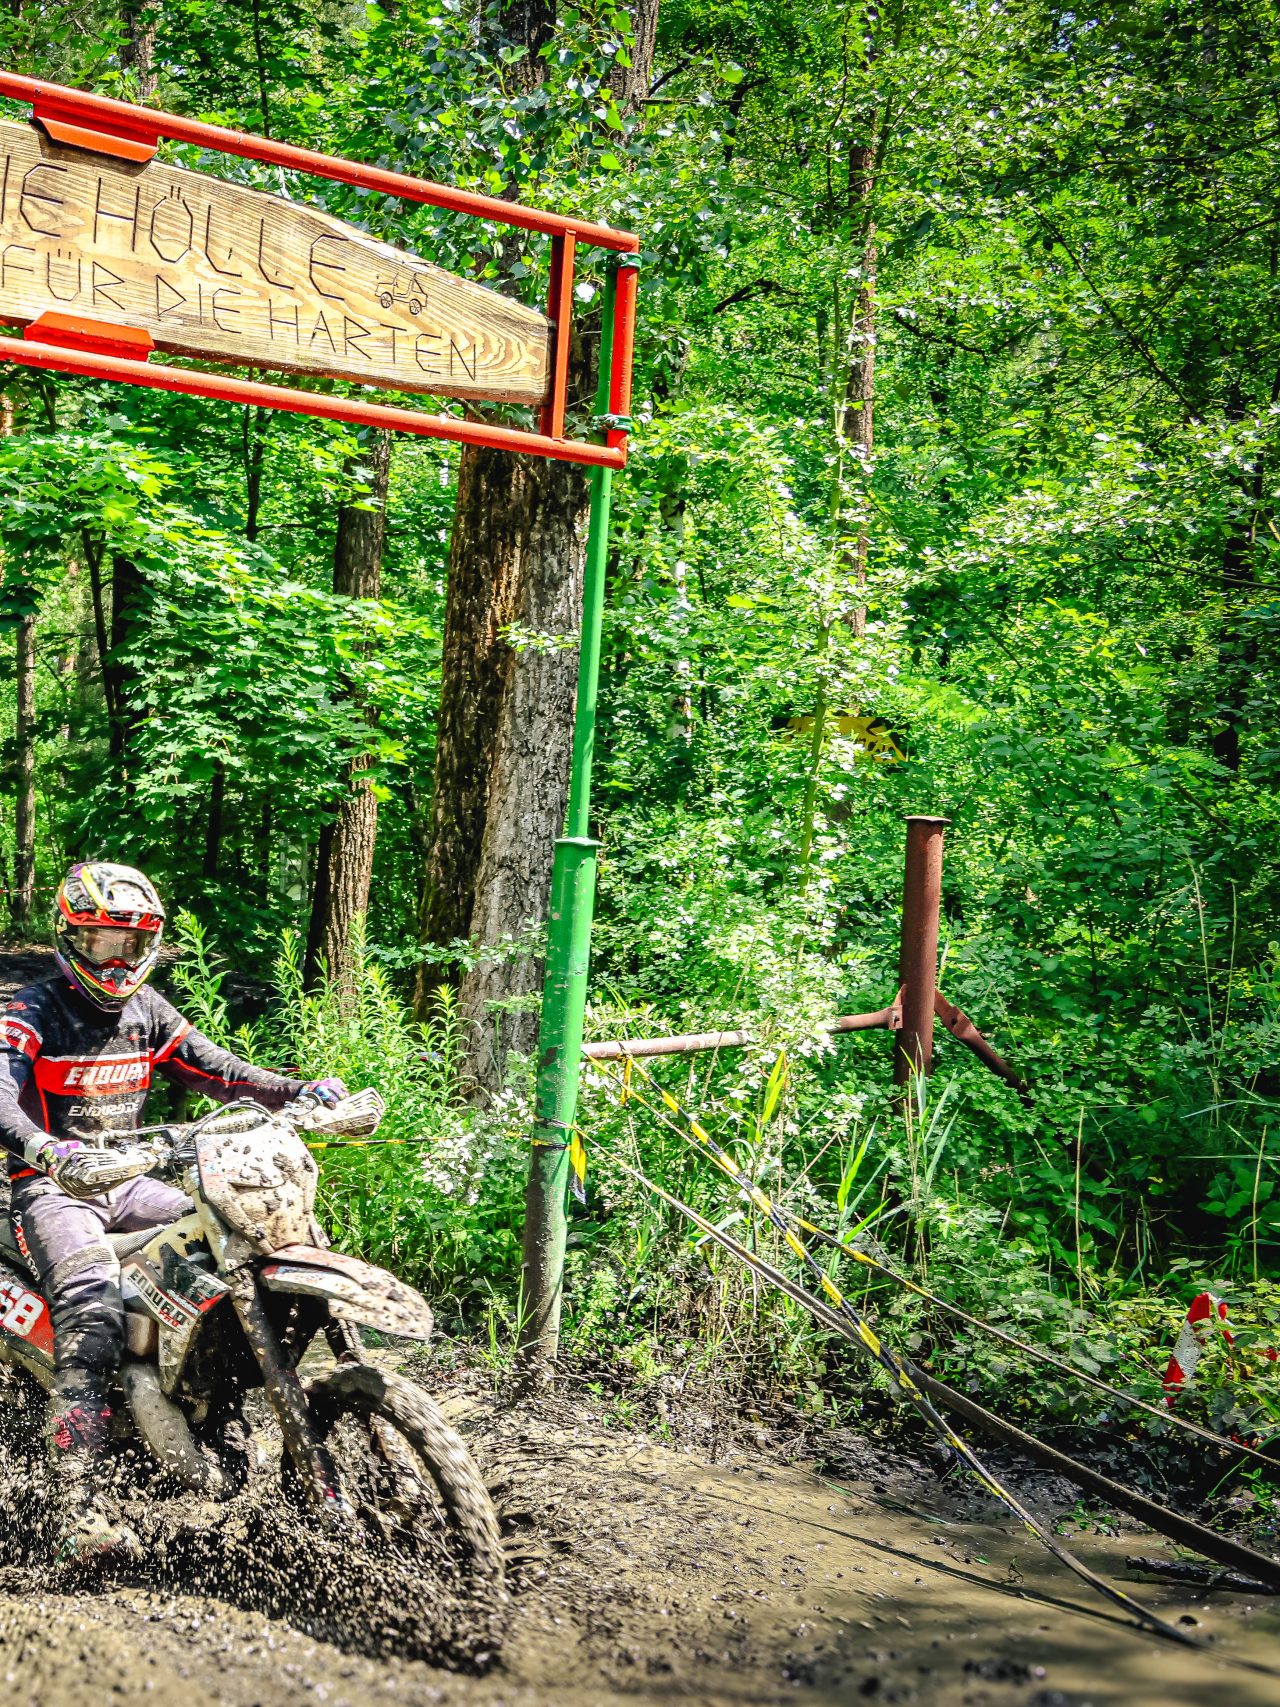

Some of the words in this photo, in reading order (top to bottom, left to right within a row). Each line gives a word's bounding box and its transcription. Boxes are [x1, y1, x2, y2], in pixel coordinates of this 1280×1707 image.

[92, 177, 349, 302] HÖLLE
[1, 244, 126, 312] FÜR
[154, 274, 243, 336] DIE
[267, 296, 479, 383] HARTEN
